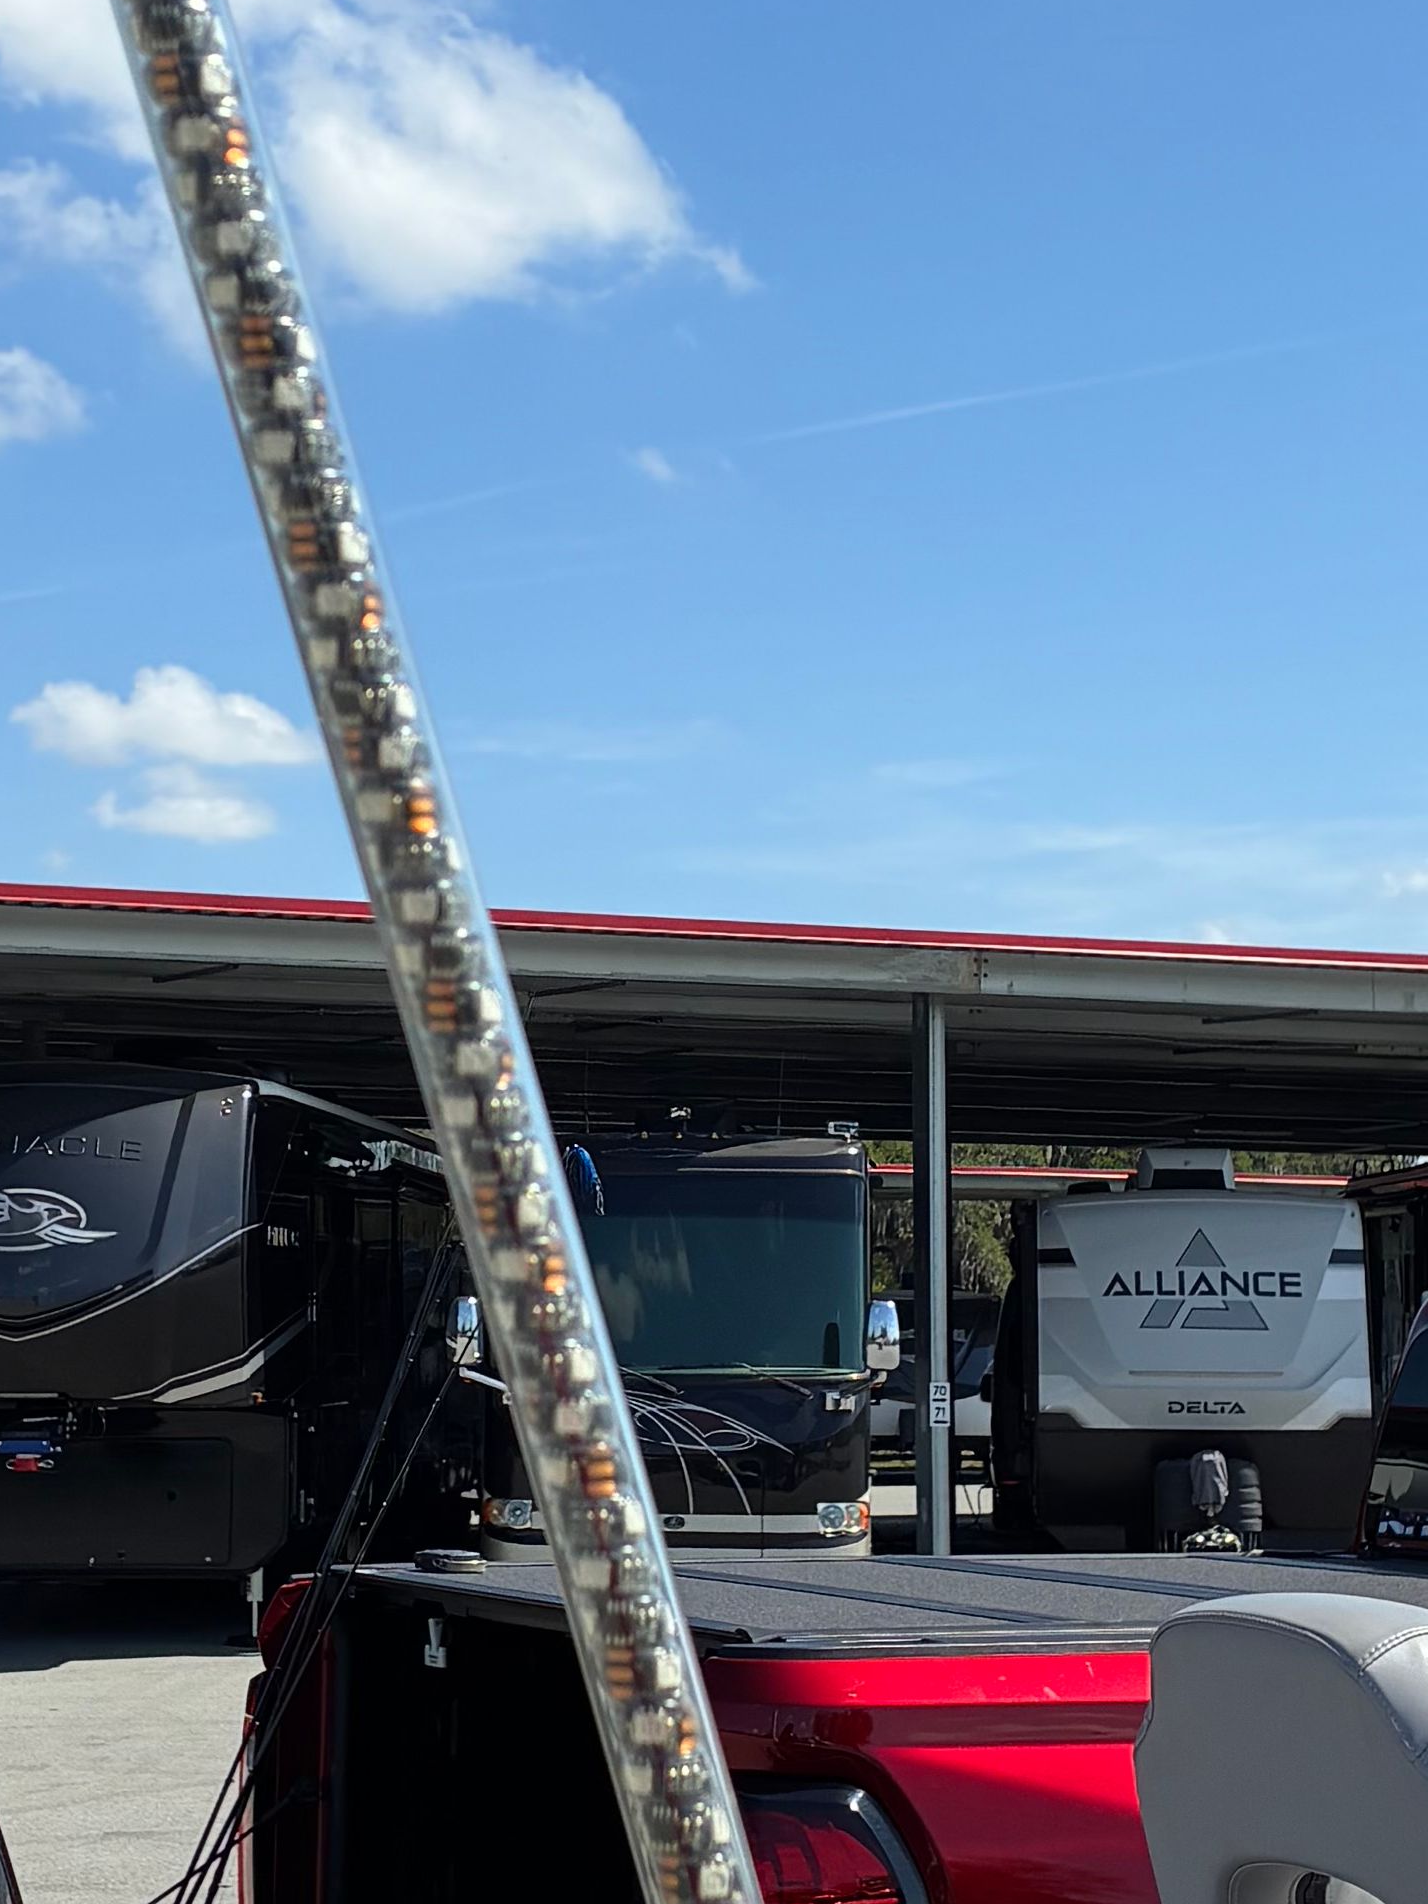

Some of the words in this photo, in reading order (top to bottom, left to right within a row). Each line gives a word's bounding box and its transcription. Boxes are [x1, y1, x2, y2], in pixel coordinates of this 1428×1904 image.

[1102, 1270, 1303, 1297] ALLIANCE
[933, 1385, 947, 1396] 70
[935, 1406, 946, 1418] 71
[1167, 1401, 1246, 1414] DELTA
